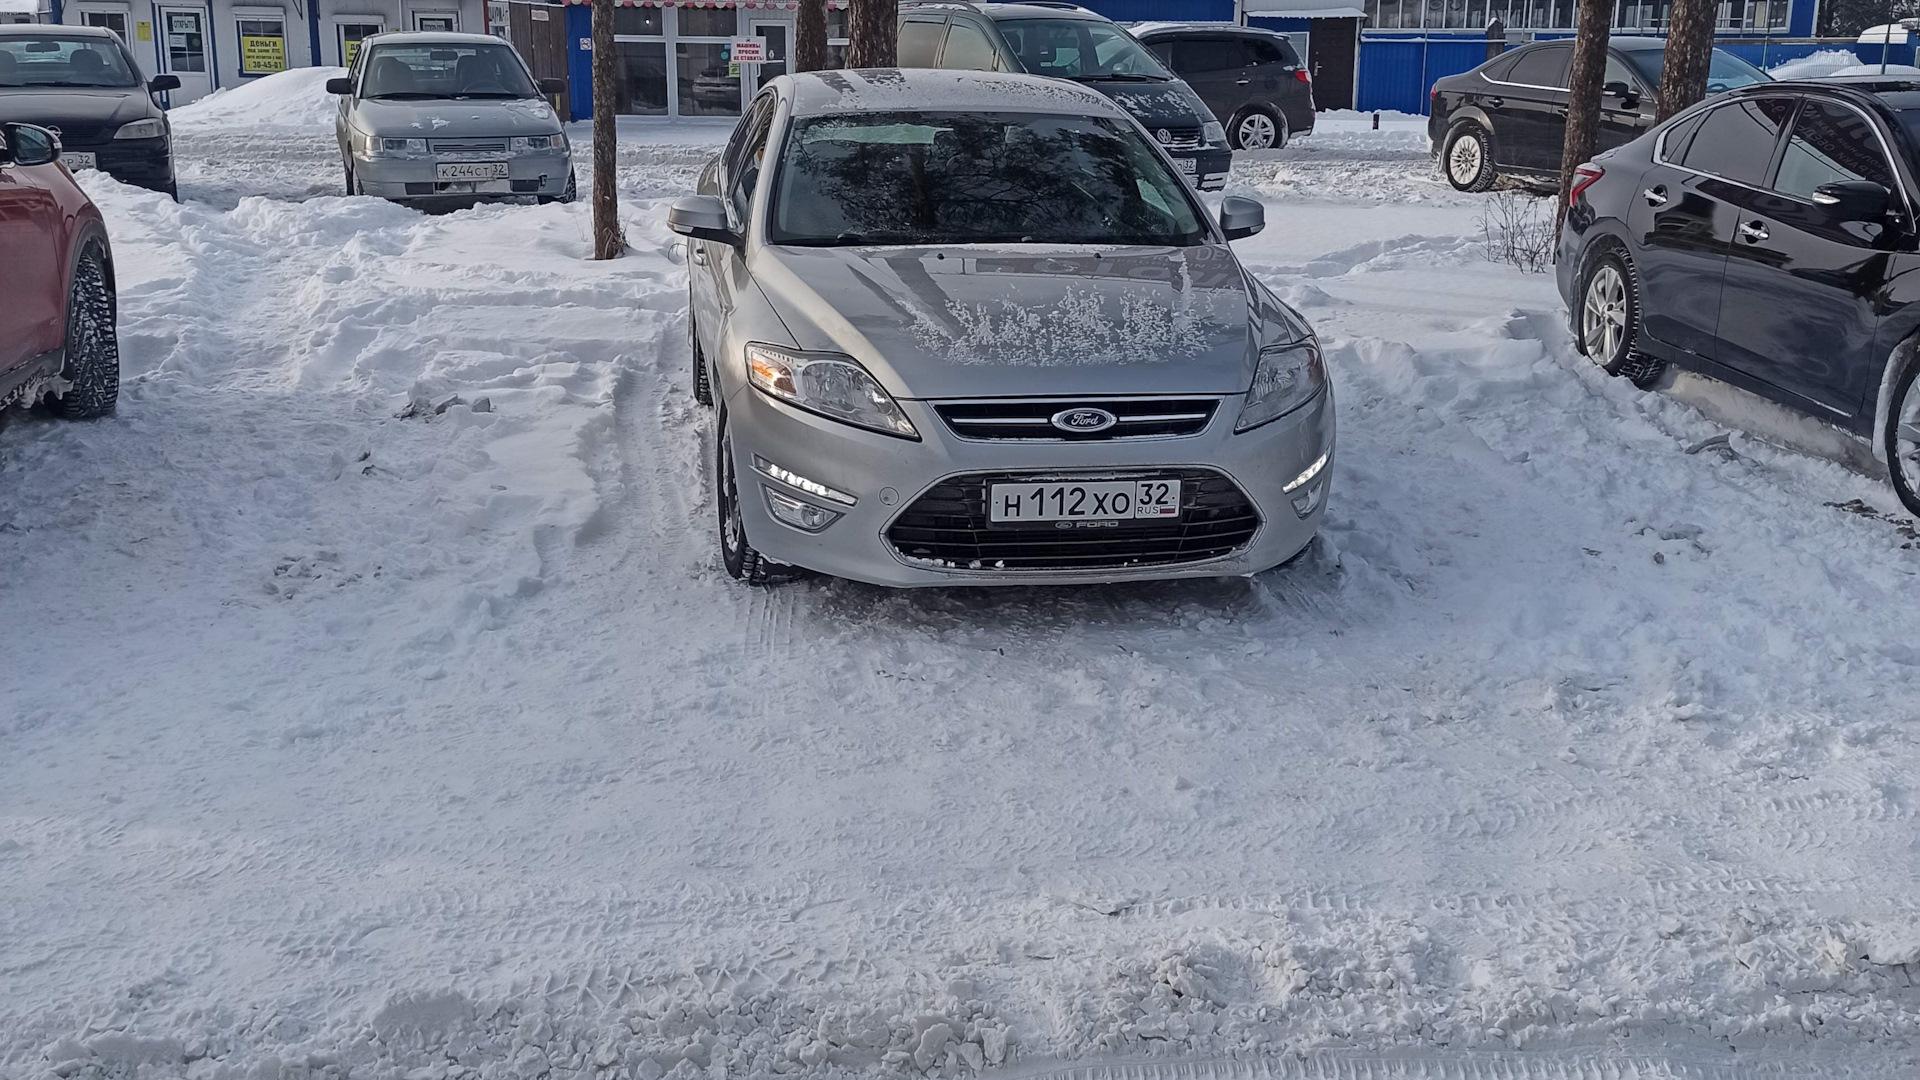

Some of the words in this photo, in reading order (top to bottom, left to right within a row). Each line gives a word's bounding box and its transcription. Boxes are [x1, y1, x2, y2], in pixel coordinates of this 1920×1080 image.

[78, 155, 90, 164] 32
[1184, 160, 1194, 168] 32
[442, 164, 490, 177] К244СТ
[492, 164, 504, 173] 32
[1071, 412, 1099, 426] Ford
[1004, 487, 1130, 517] Н112ХО
[1139, 483, 1169, 505] 32
[1137, 506, 1159, 514] RUS
[1076, 521, 1119, 529] FORD
